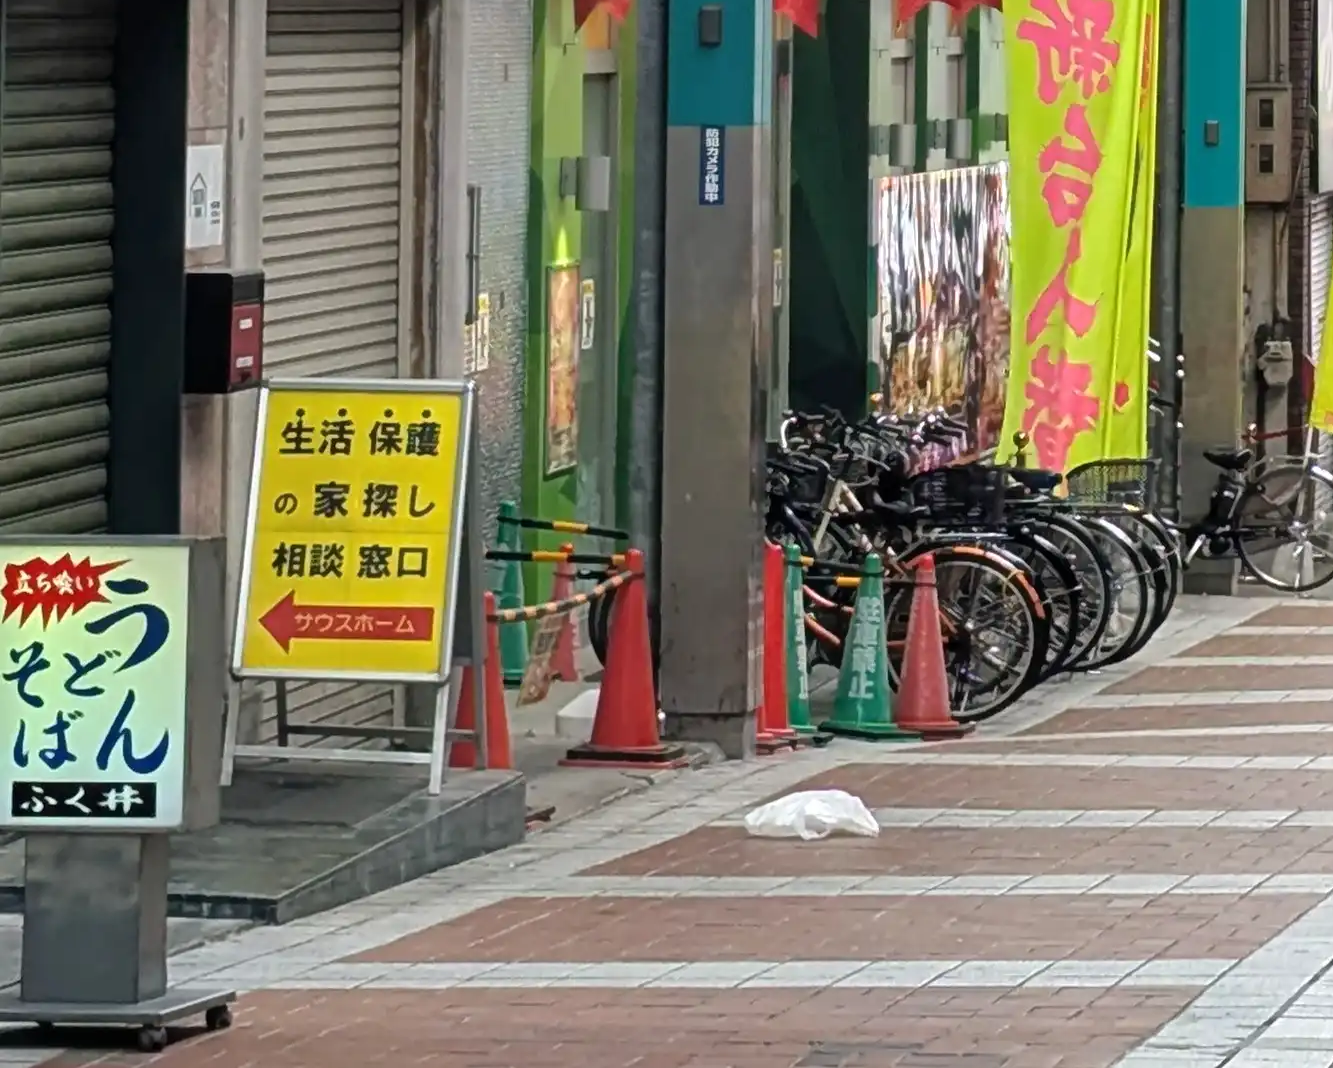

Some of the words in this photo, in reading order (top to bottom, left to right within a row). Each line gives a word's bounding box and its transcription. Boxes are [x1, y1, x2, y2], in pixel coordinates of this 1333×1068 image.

[705, 128, 720, 202] 防犯カメラ作動中
[279, 419, 442, 458] 生活保護
[272, 542, 428, 579] 相談窓口
[14, 571, 93, 595] 立ち喰い
[294, 613, 415, 634] サウスホーム
[20, 785, 144, 814] ふく井
